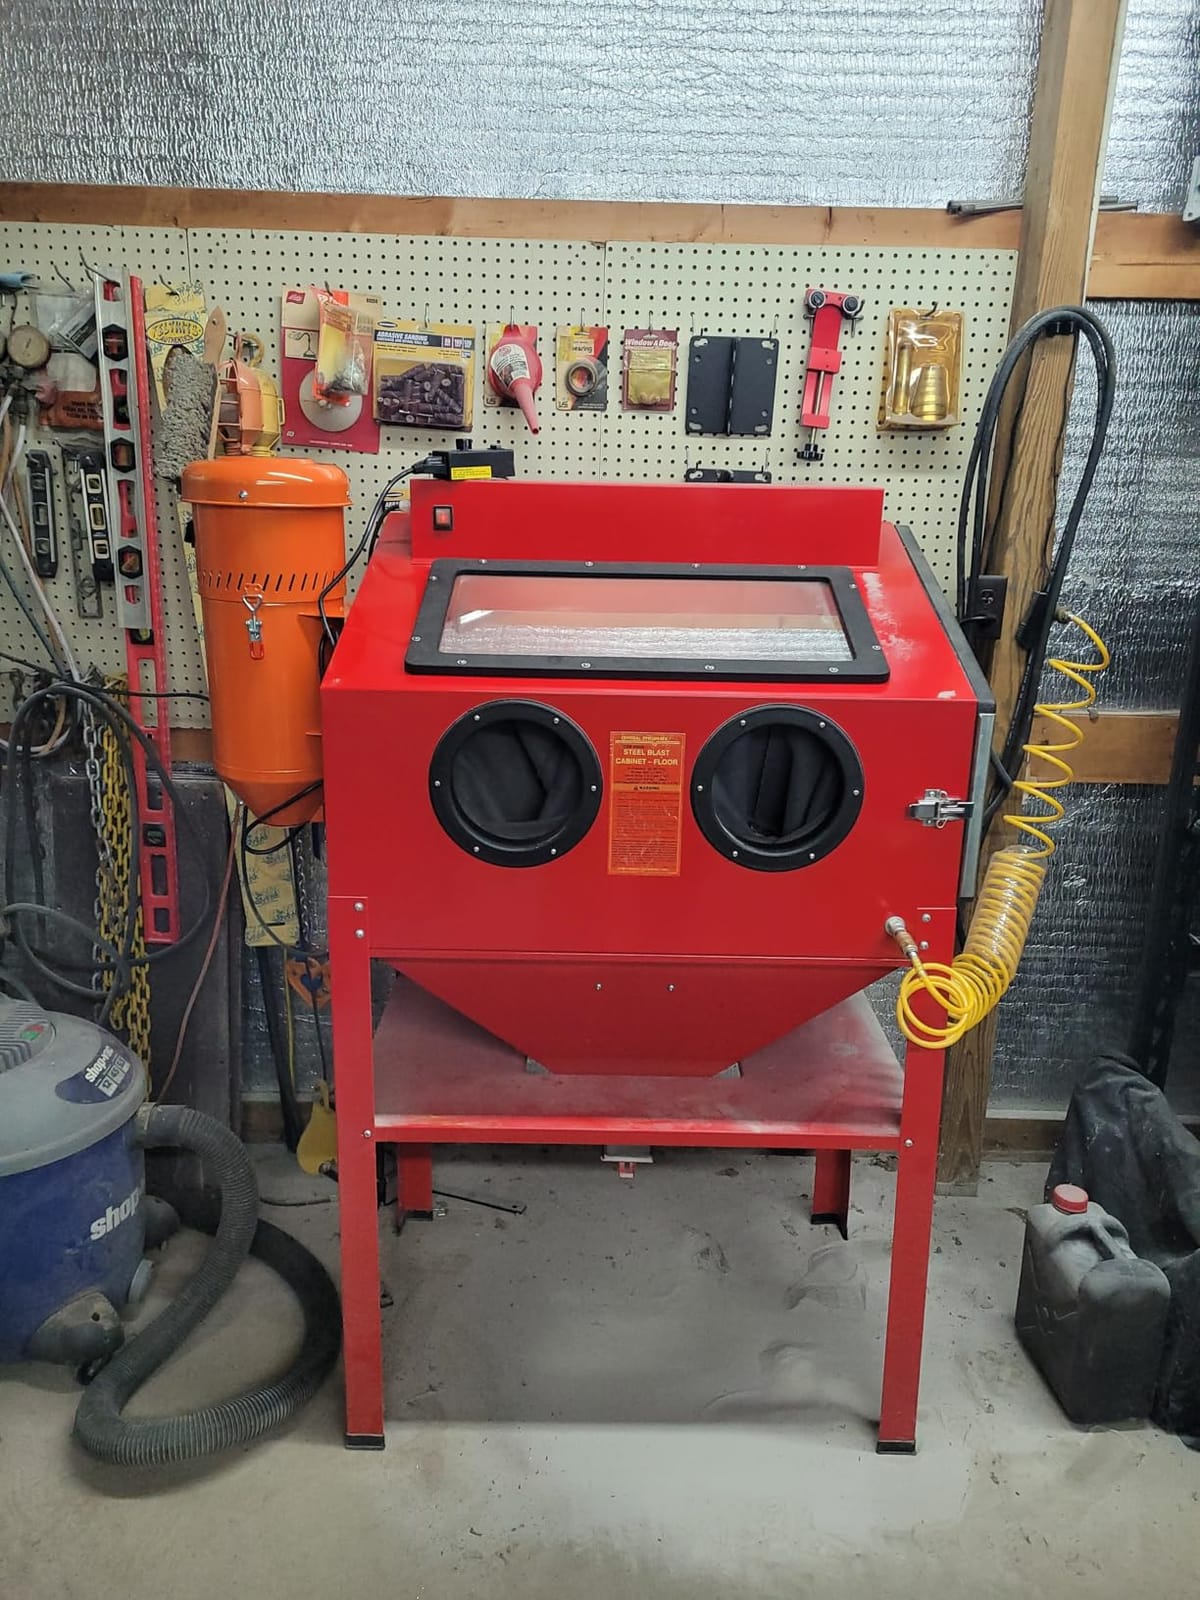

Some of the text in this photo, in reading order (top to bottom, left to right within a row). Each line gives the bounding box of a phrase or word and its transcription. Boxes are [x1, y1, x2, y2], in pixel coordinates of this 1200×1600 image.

[625, 339, 653, 347] Window
[653, 758, 678, 766] FLOOR
[90, 1186, 139, 1241] shop
